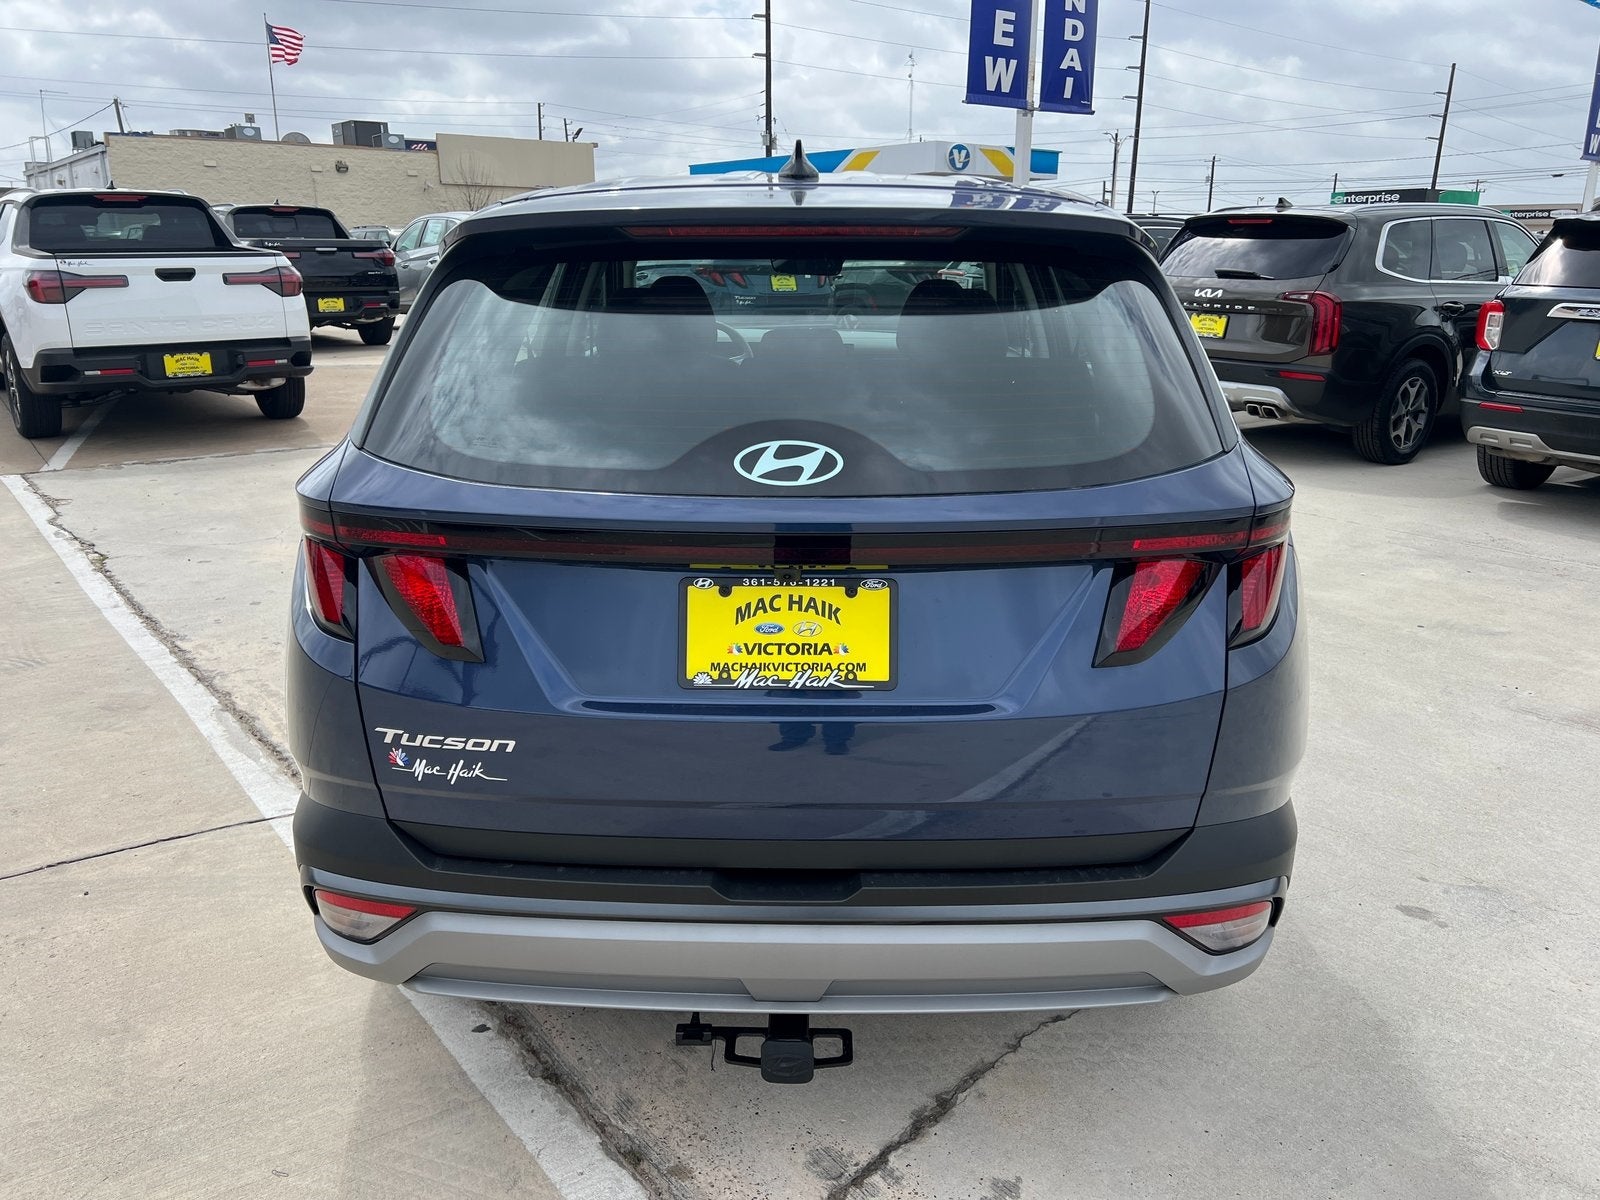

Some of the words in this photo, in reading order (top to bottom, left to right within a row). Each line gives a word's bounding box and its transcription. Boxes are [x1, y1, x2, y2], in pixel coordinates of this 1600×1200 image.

[1332, 192, 1400, 204] enterprise
[735, 594, 782, 626] MAC
[787, 594, 841, 626] HAIK
[759, 624, 780, 633] Ford
[743, 642, 834, 656] VICTORIA
[710, 662, 867, 672] MACHAIKVICTORIA.COM
[730, 667, 787, 689] Mac
[788, 668, 863, 690] Haik
[407, 758, 447, 782] Mac
[446, 759, 501, 785] Haik
